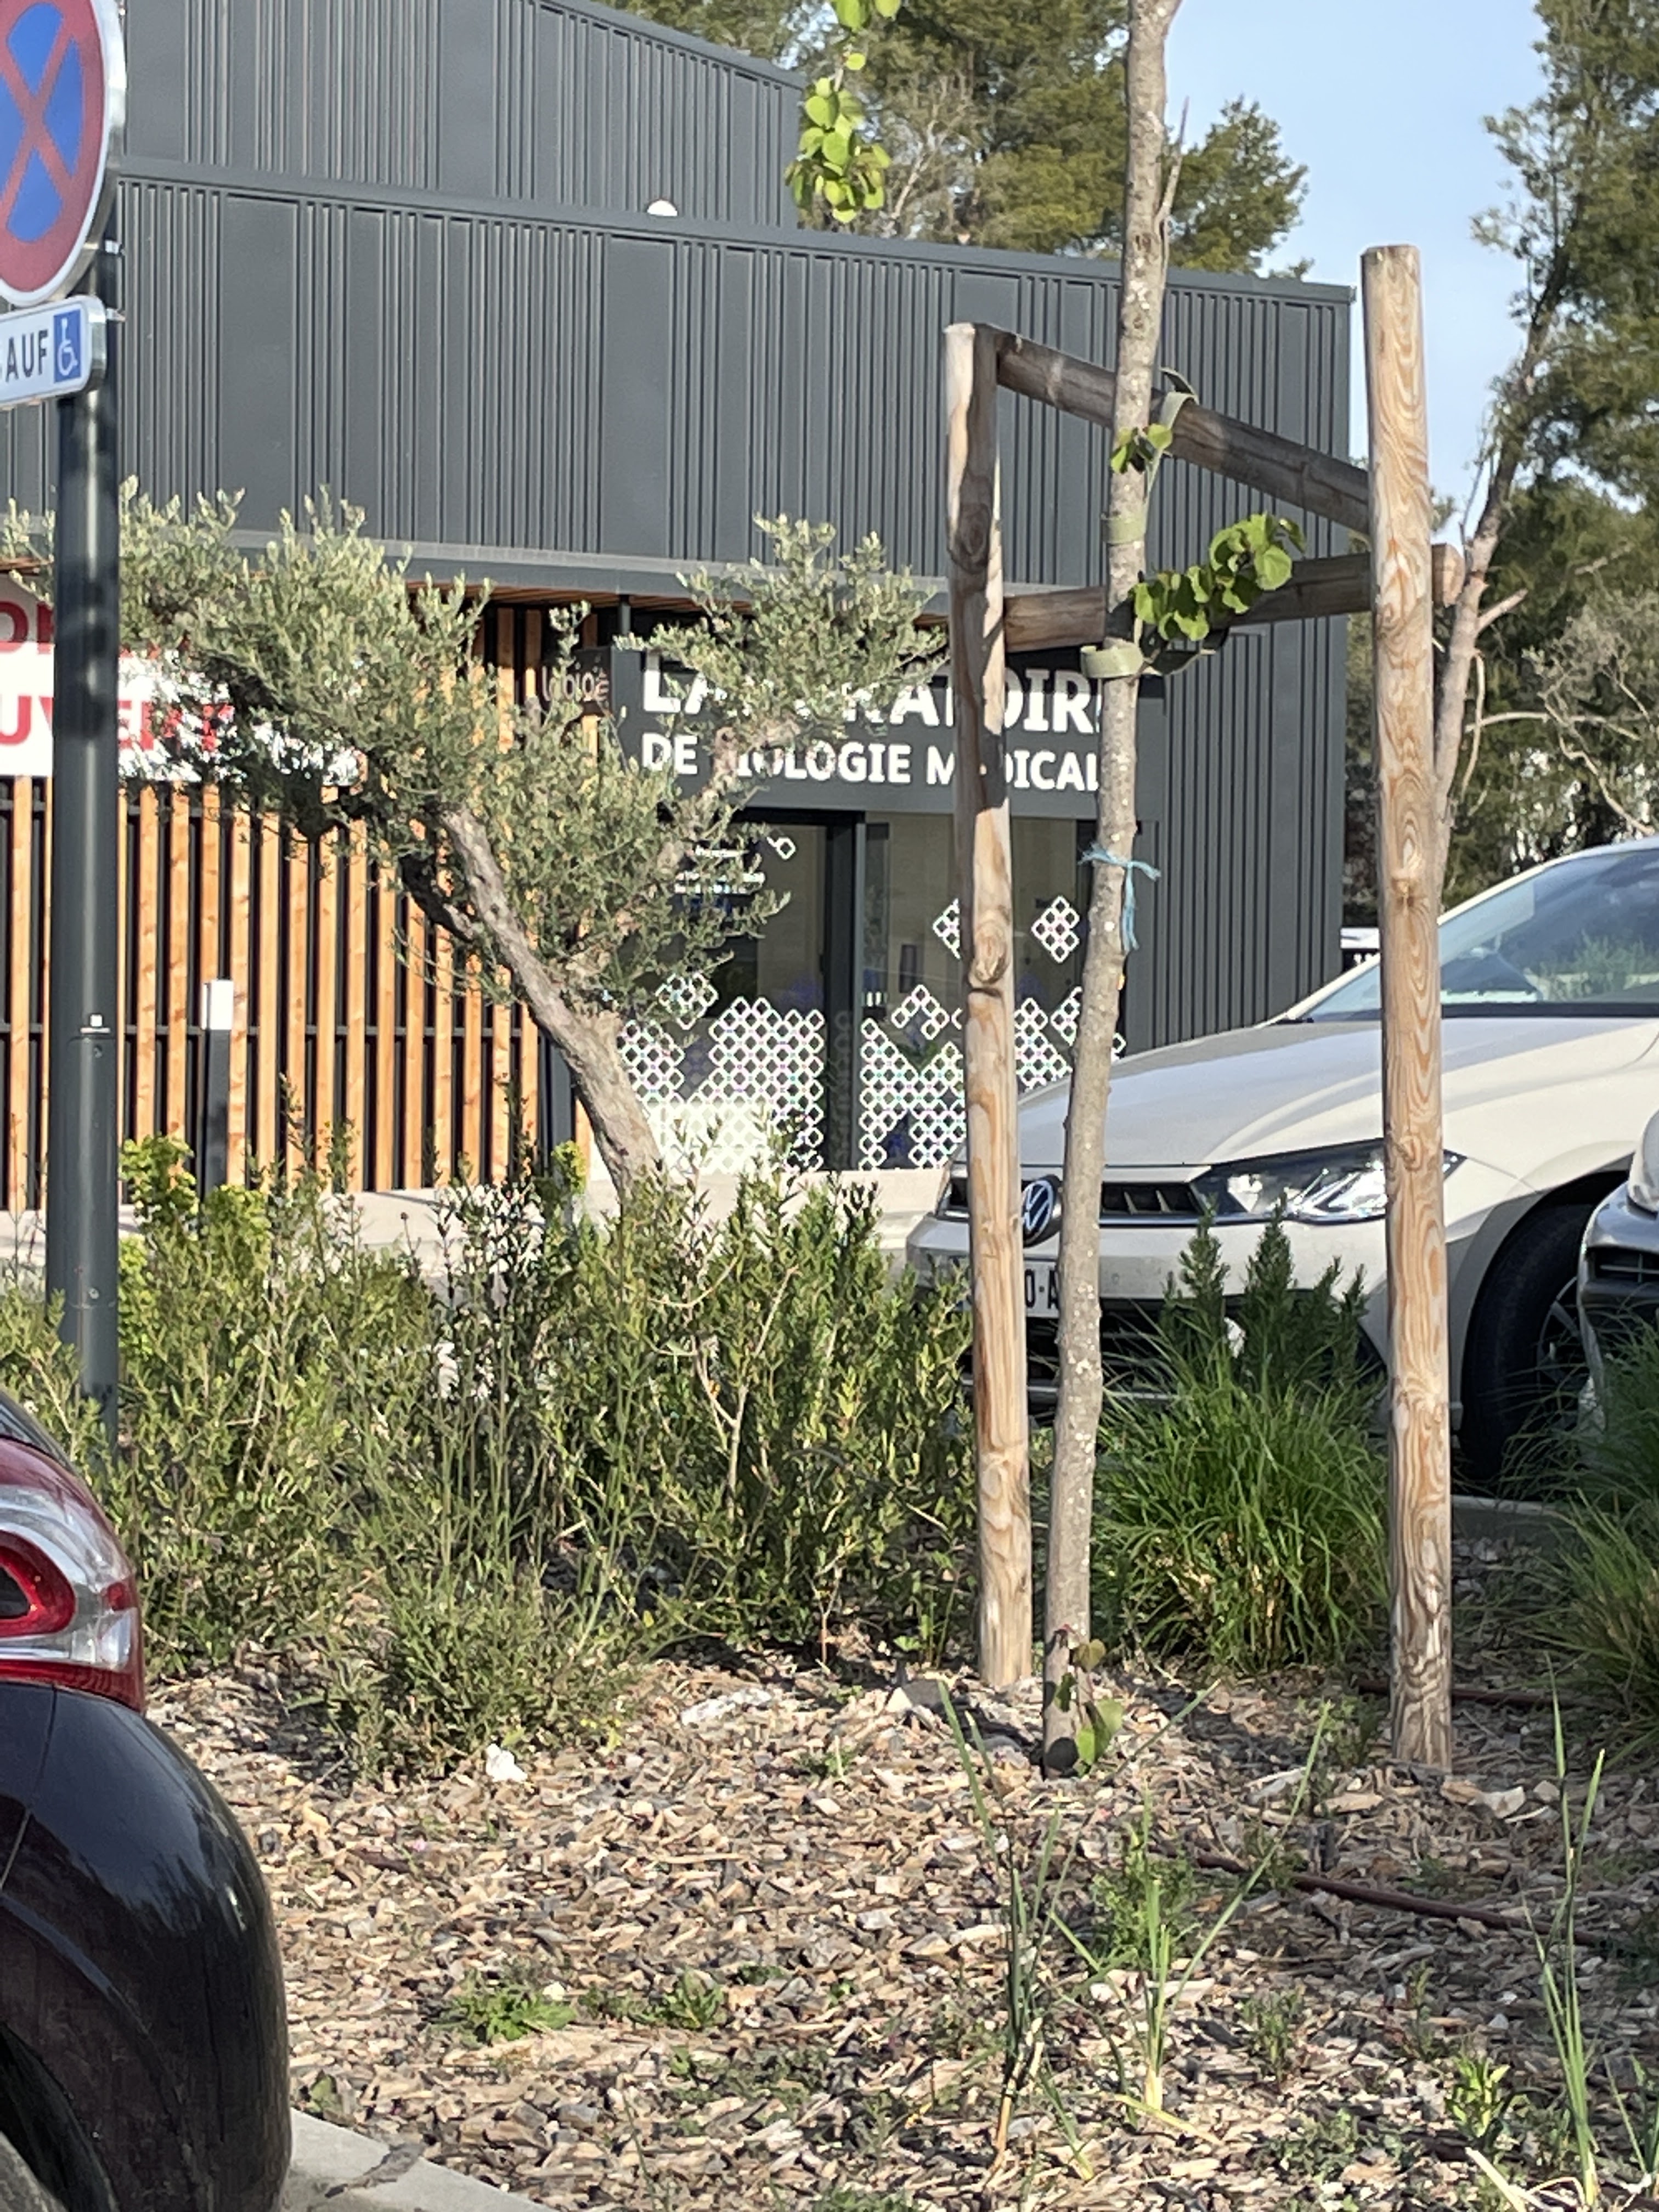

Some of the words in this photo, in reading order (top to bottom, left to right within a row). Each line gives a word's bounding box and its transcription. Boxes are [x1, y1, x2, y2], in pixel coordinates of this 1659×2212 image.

[0, 329, 48, 383] AUF
[642, 732, 698, 775] DE
[737, 741, 911, 783] IOLOGIE
